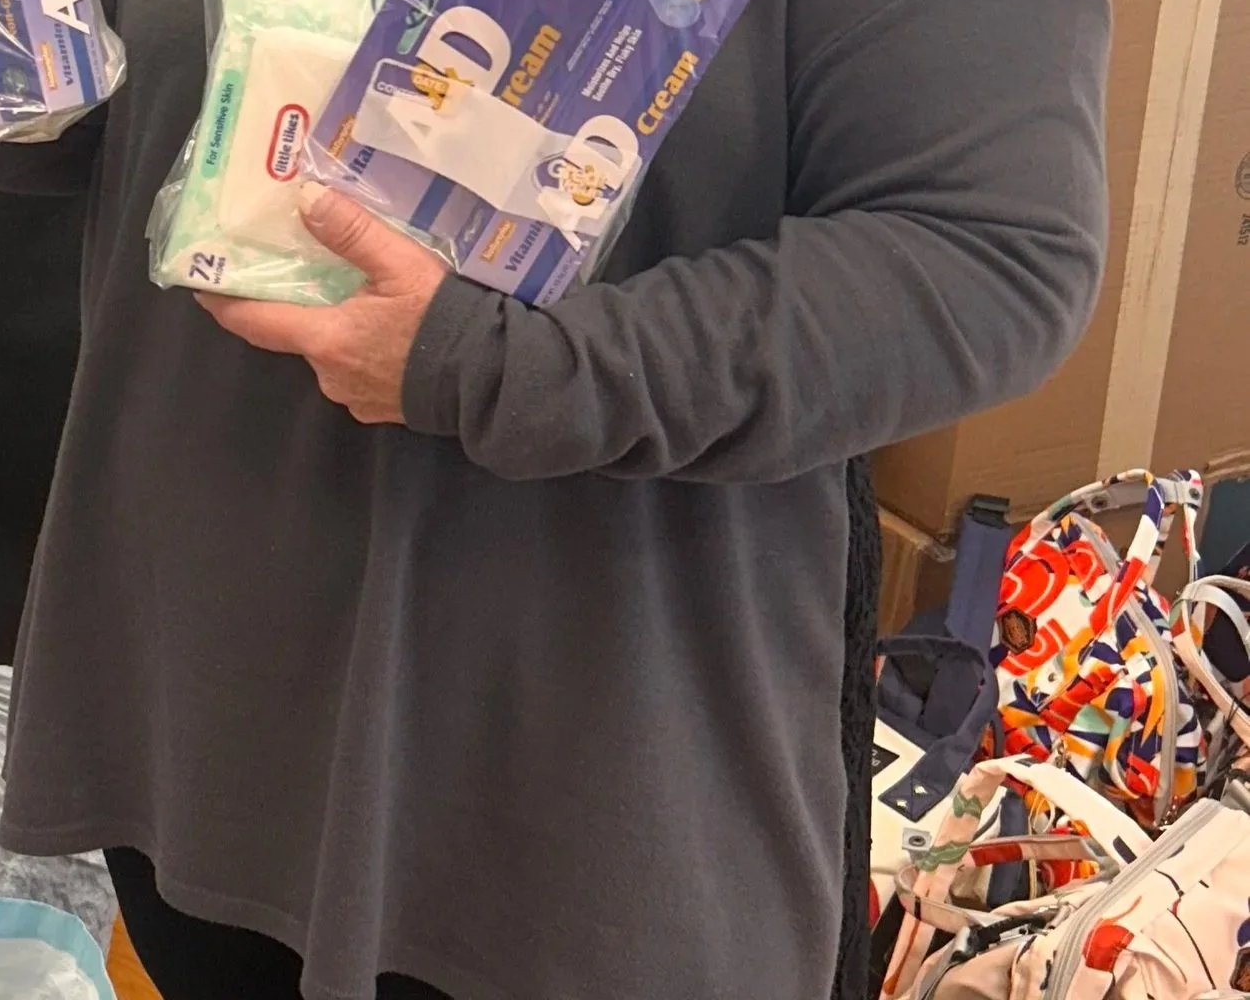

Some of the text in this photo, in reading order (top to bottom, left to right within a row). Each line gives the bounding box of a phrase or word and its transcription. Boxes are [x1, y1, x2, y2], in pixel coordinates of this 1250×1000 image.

[500, 24, 562, 107] ream
[636, 50, 700, 135] Cream
[206, 83, 235, 166] For Sensitive Skin
[189, 251, 216, 282] 72
